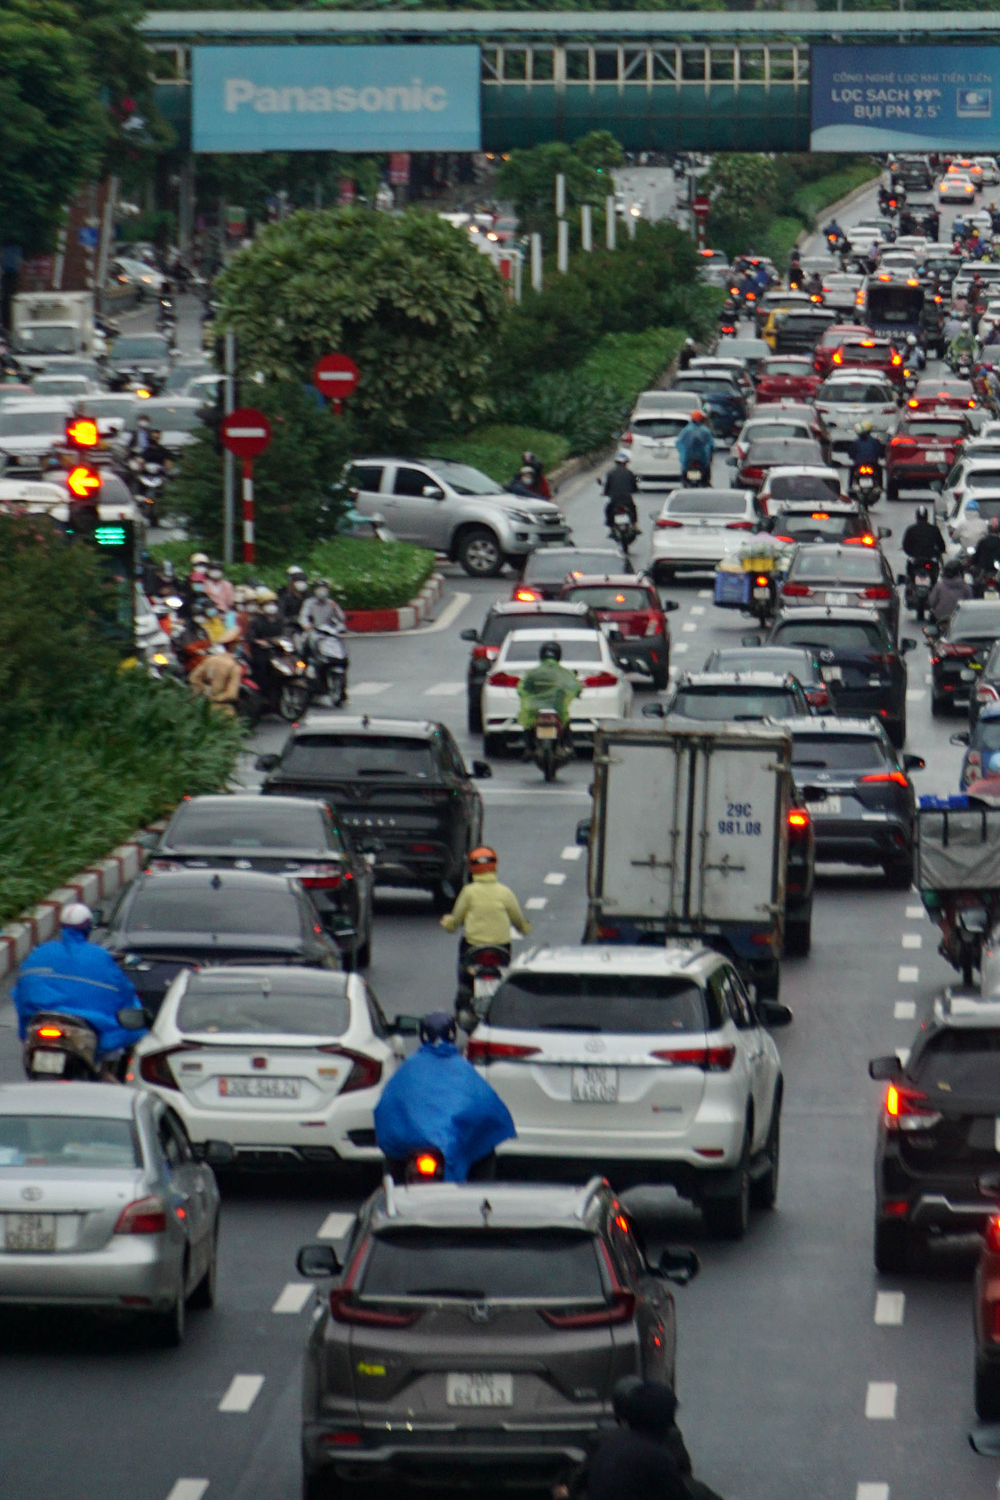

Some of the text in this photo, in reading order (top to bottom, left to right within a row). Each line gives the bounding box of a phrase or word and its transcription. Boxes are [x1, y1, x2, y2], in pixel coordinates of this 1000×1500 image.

[225, 77, 448, 113] Panasonic
[831, 89, 862, 104] LỌC
[866, 88, 909, 105] SẠCH
[854, 105, 881, 120] BỤI
[885, 105, 910, 118] PM
[727, 803, 752, 817] 29C
[718, 821, 762, 835] 981.08
